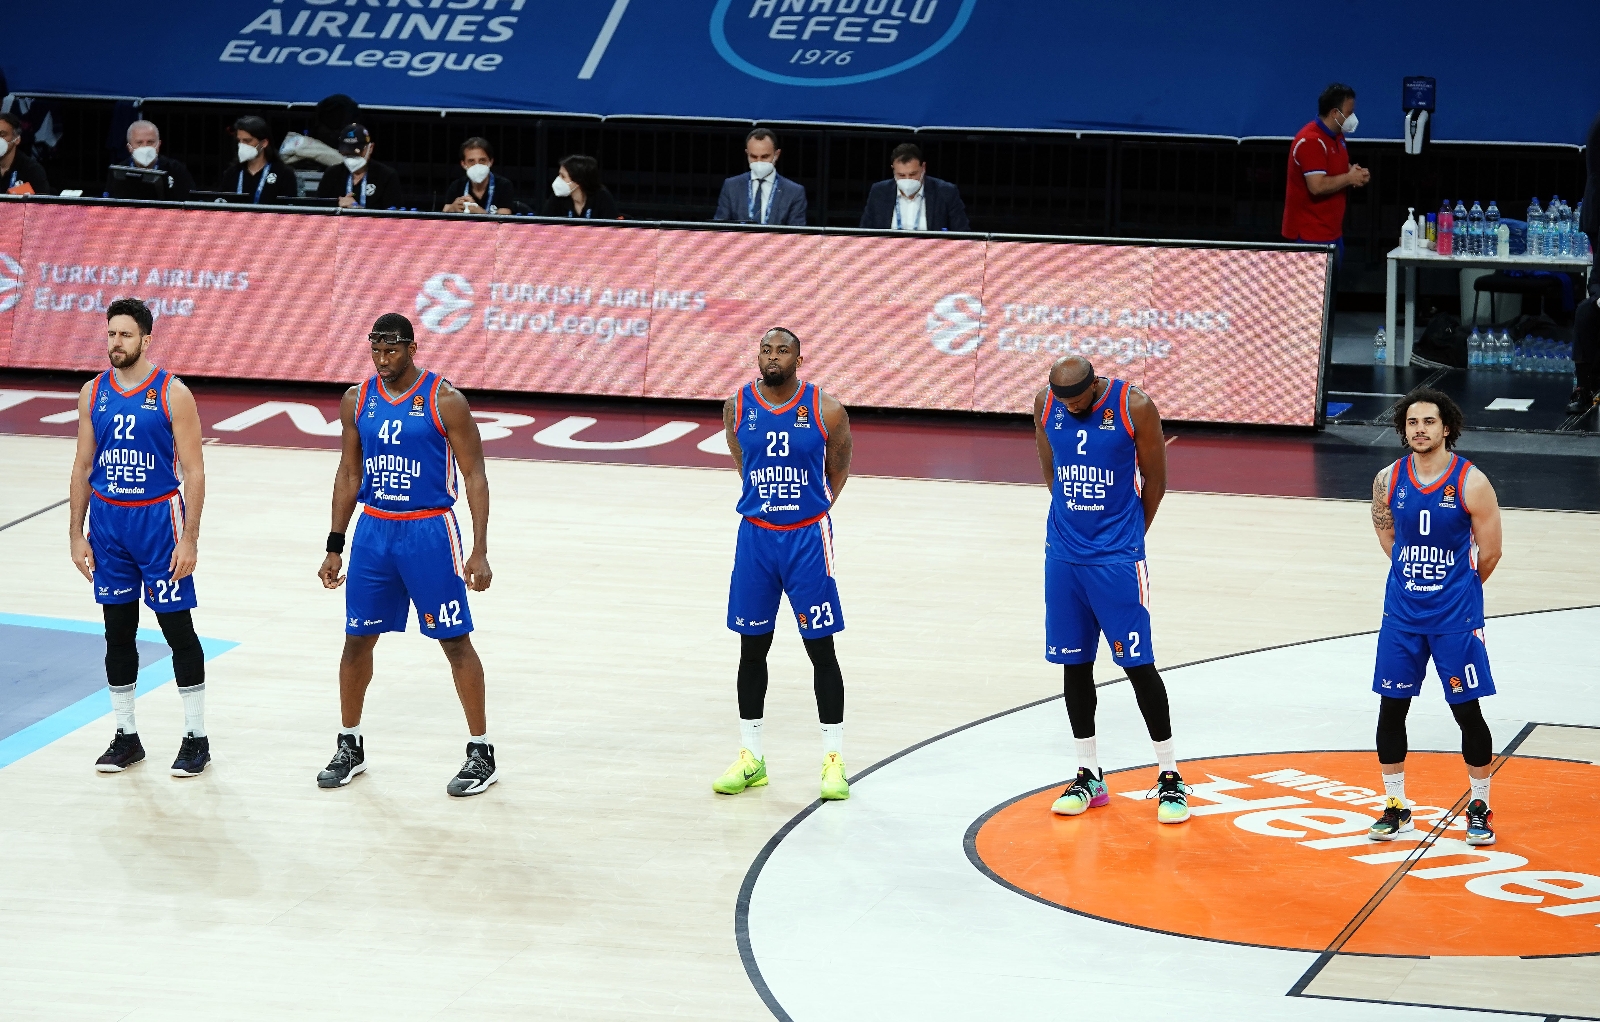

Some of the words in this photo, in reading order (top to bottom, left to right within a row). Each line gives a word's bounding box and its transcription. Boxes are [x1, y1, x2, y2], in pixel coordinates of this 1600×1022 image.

[239, 8, 518, 42] AIRLINES
[769, 16, 901, 43] EFES
[219, 40, 503, 77] EuroLeague
[789, 49, 854, 65] 1976
[39, 262, 140, 285] TURKISH
[145, 267, 249, 291] AIRLINES
[489, 282, 592, 306] TURKISH
[598, 287, 706, 312] AIRLINES
[484, 307, 650, 343] EuroLeague
[1003, 303, 1110, 327] TURKISH
[1116, 307, 1230, 332] AIRLINES
[998, 328, 1172, 365] EuroLeague
[113, 414, 136, 440] 22
[378, 419, 402, 445] 42
[766, 431, 789, 457] 23
[1076, 429, 1088, 455] 2
[99, 448, 155, 470] ANADOLU
[106, 465, 147, 482] EFES
[372, 471, 411, 489] EFES
[750, 466, 809, 487] ANADOLU
[1058, 464, 1114, 486] ANADOLU
[758, 483, 801, 499] EFES
[1063, 481, 1106, 499] EFES
[1419, 509, 1431, 536] 0
[1403, 562, 1447, 580] EFES
[156, 579, 181, 603] 22
[438, 600, 463, 628] 42
[810, 601, 834, 629] 23
[1128, 631, 1140, 657] 2
[1464, 663, 1479, 689] 0
